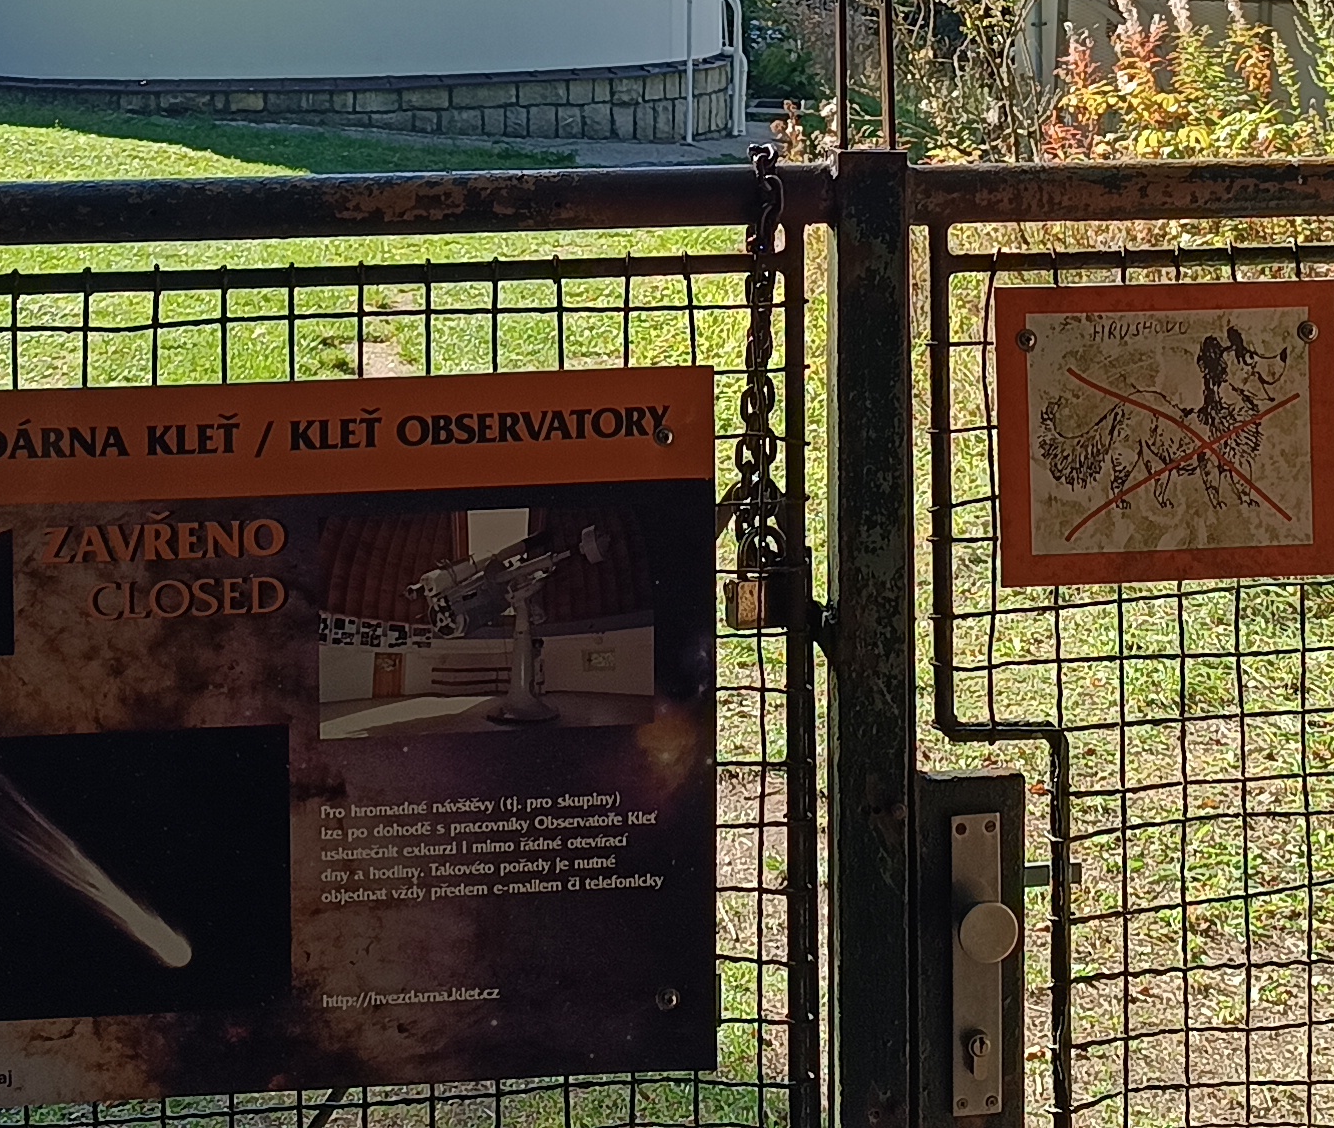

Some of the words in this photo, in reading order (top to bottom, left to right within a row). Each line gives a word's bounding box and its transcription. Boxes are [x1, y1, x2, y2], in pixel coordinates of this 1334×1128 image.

[146, 412, 240, 456] KLEŤ
[254, 420, 274, 458] /
[290, 407, 382, 451] KLEŤ
[396, 405, 670, 447] OBSERVATORY
[41, 510, 286, 564] ZAVŘENO
[88, 576, 286, 619] CLOSED
[320, 806, 345, 819] Pro
[351, 801, 427, 818] hromadné
[432, 797, 495, 814] návštěvy
[500, 796, 522, 813] (tj.
[526, 797, 552, 812] pro
[557, 791, 620, 809] skupiny)
[321, 826, 343, 840] lze
[348, 827, 367, 842] po
[373, 821, 431, 837] dohodě
[436, 823, 445, 835] s
[450, 817, 530, 837] pracovníky
[535, 812, 623, 830] Observatoře
[627, 810, 658, 825] Kleť
[321, 844, 398, 861] uskutečnit
[403, 840, 457, 857] exkurzi
[472, 838, 515, 854] mimo
[520, 836, 562, 851] řádné
[567, 832, 628, 849] otevírací
[321, 869, 349, 884] dny
[354, 870, 364, 881] a
[369, 865, 425, 884] hodiny.
[429, 861, 494, 876] Takovéto
[500, 858, 551, 876] pořady
[555, 857, 569, 873] je
[574, 854, 616, 869] nutné
[321, 888, 387, 905] objednat
[392, 883, 426, 900] vždy
[431, 882, 487, 900] předem
[493, 879, 562, 894] e-mailem
[568, 876, 579, 891] či
[585, 873, 664, 890] telefonicky
[322, 987, 501, 1010] http://hvezdarna.klet.cz
